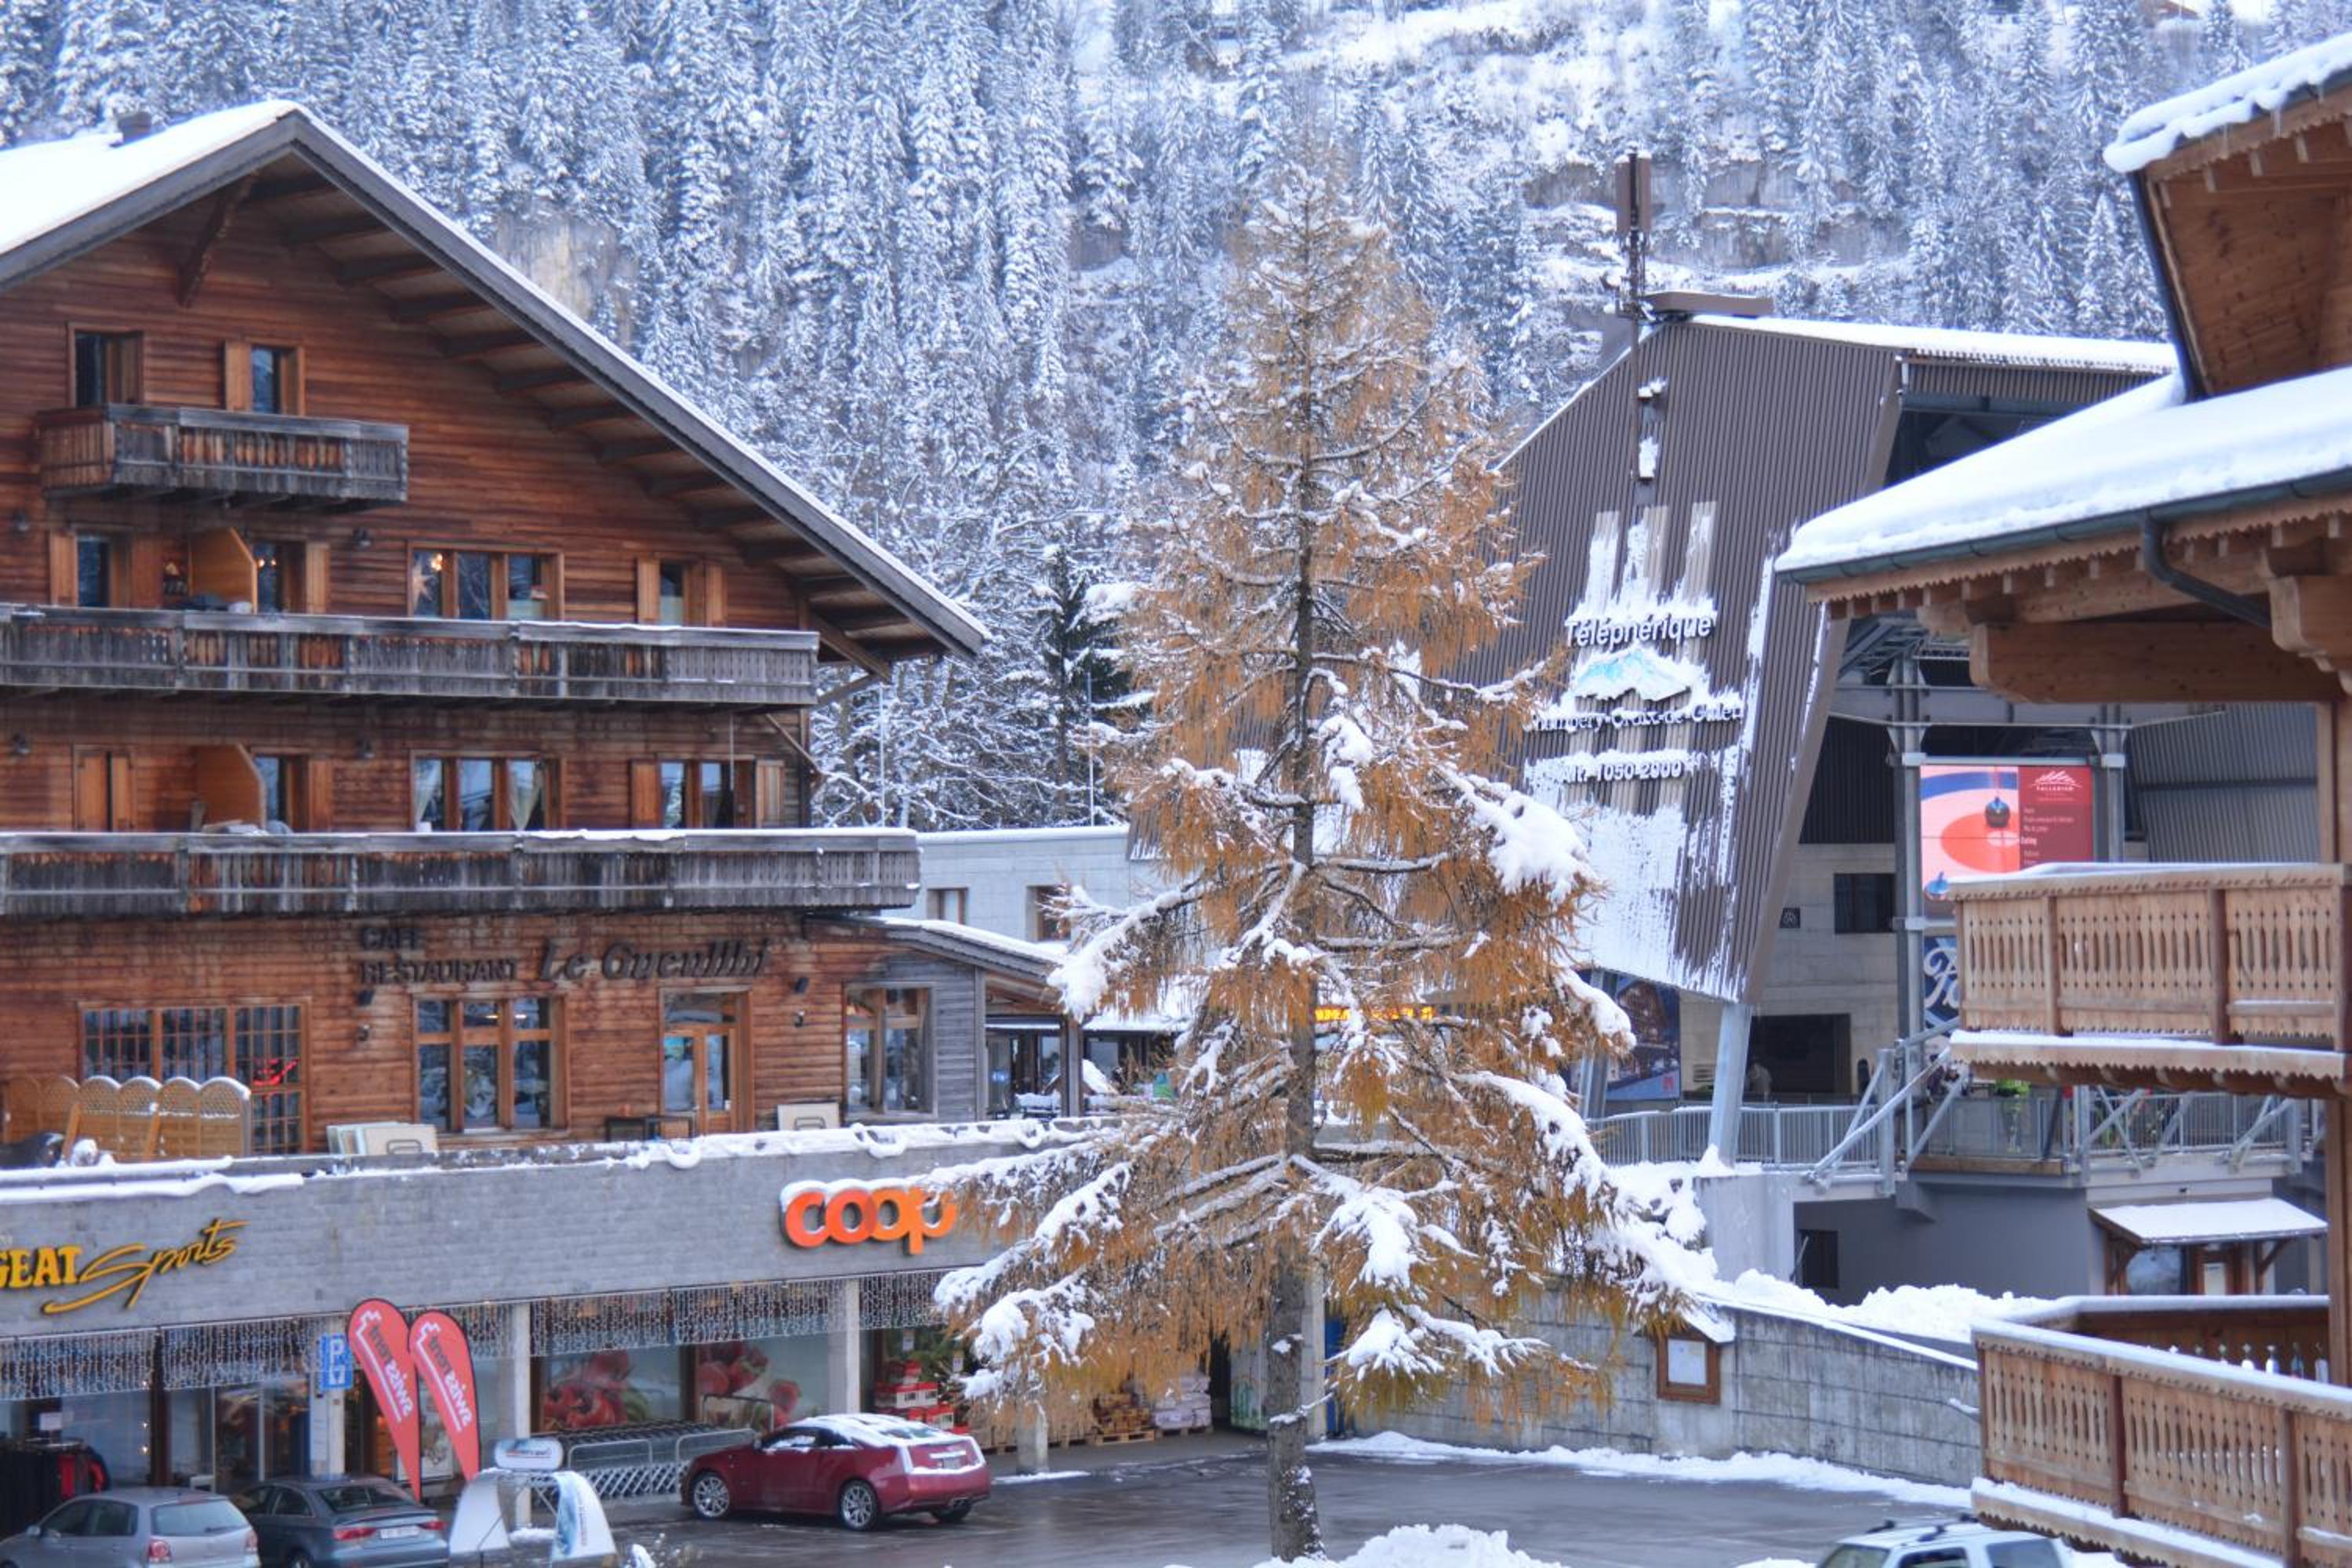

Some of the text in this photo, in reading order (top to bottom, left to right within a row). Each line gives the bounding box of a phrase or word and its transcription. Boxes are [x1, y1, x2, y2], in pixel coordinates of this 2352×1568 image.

[1565, 613, 1712, 653] Téléphérique
[360, 956, 517, 985] RESTAURANT
[539, 941, 597, 981] Le
[42, 1218, 251, 1314] Sports
